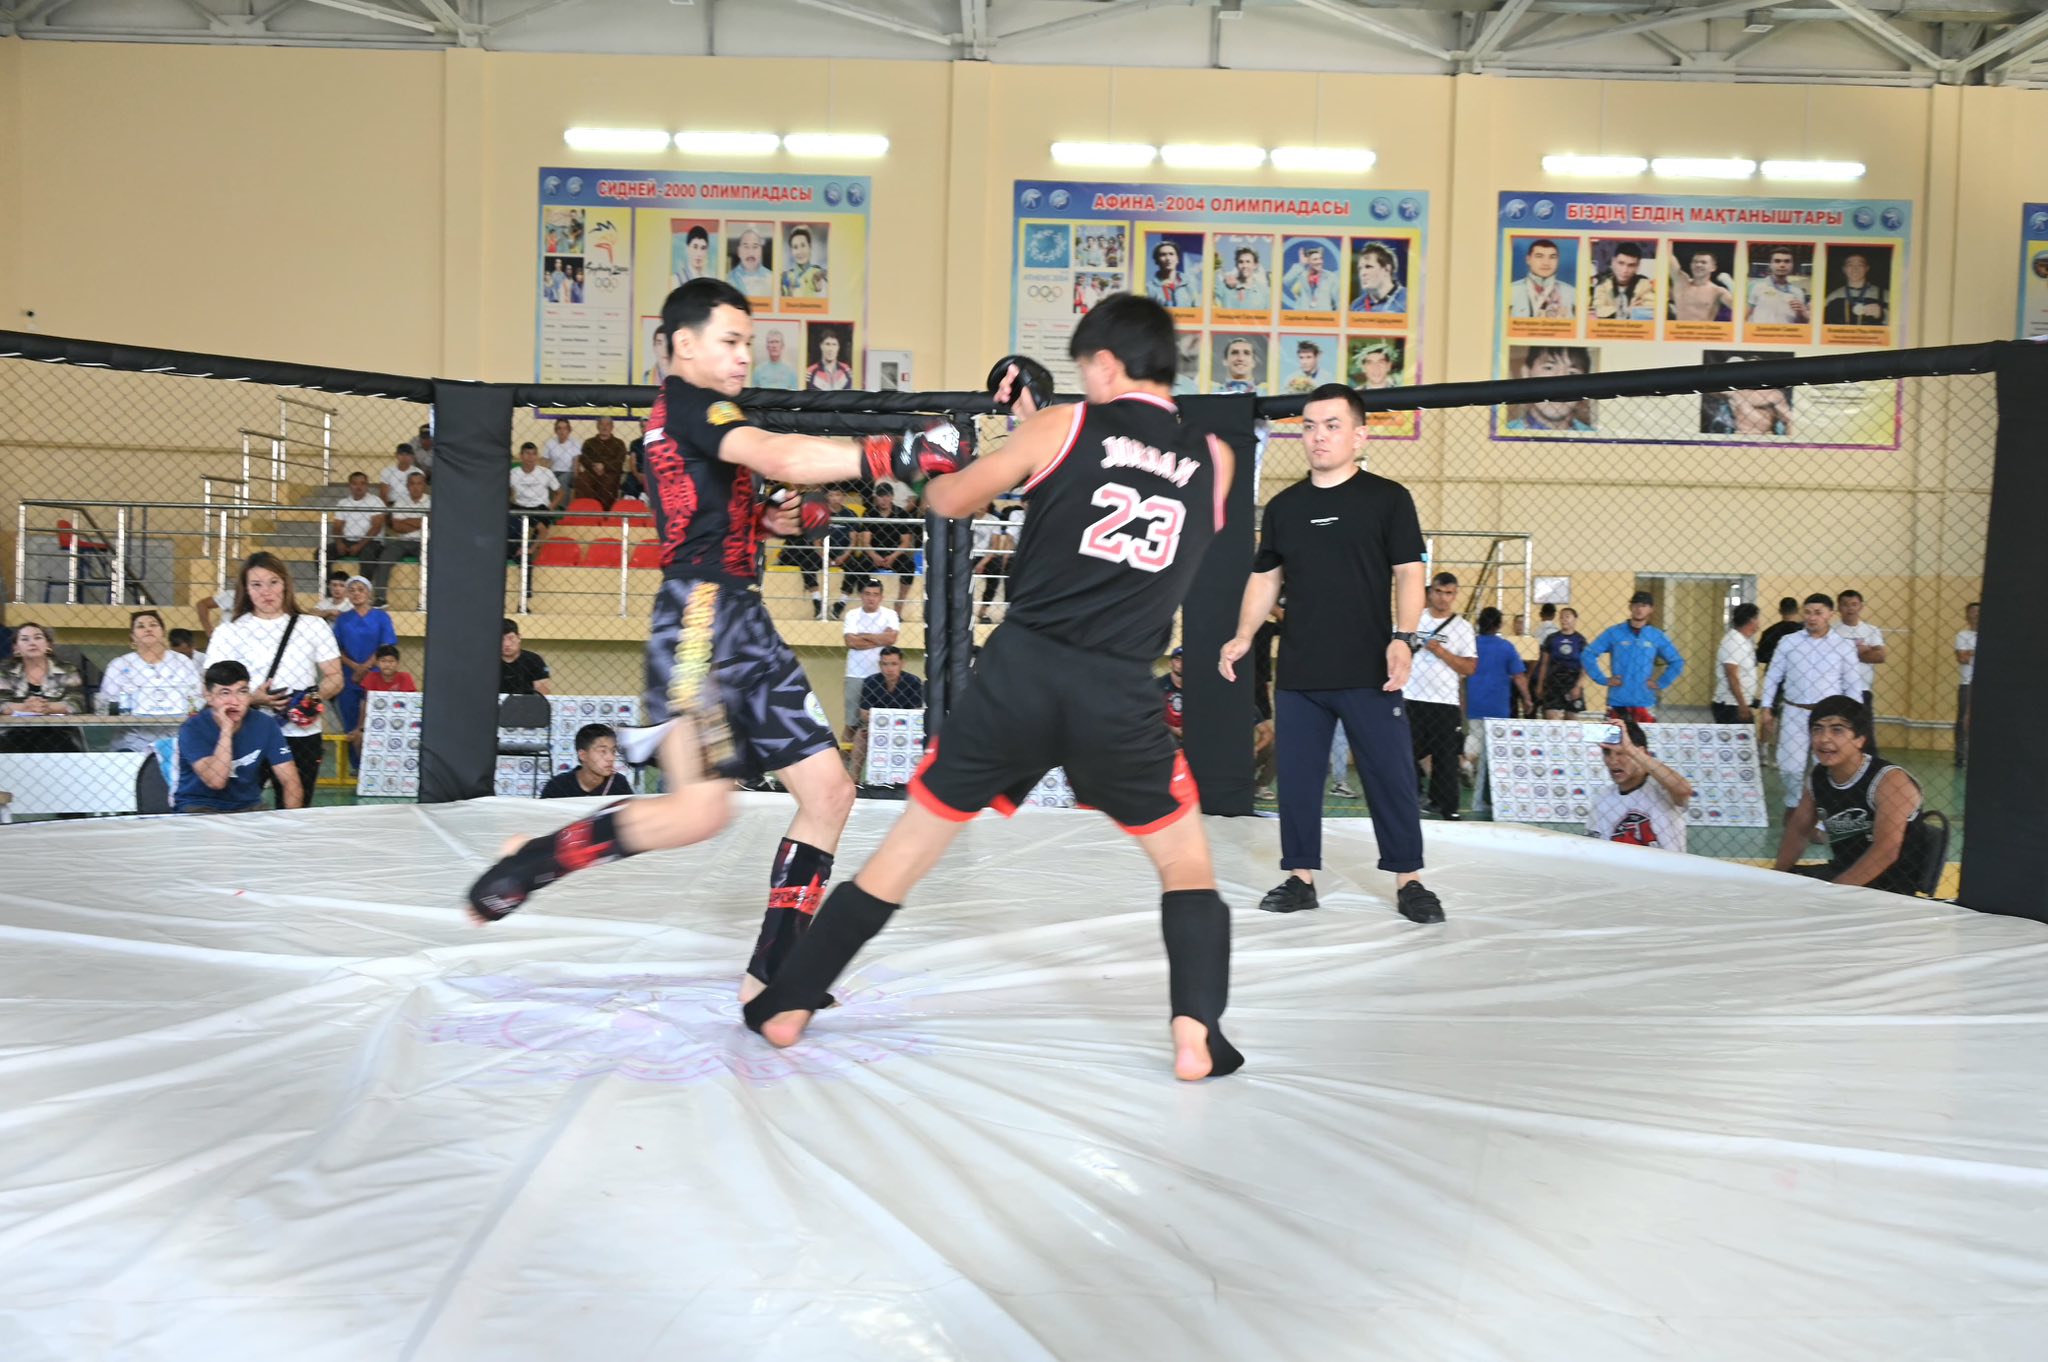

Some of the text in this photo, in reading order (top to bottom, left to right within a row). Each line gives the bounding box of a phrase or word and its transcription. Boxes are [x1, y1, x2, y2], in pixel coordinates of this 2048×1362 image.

[701, 184, 813, 201] ОЛИМПИАДАСЫ
[1211, 198, 1350, 216] ОЛИМПИАДАСЫ
[1567, 204, 1843, 226] БІЗДІҢ ЕЛДІҢ МАҚТАНЫШТАРЫ
[1078, 482, 1187, 573] 23
